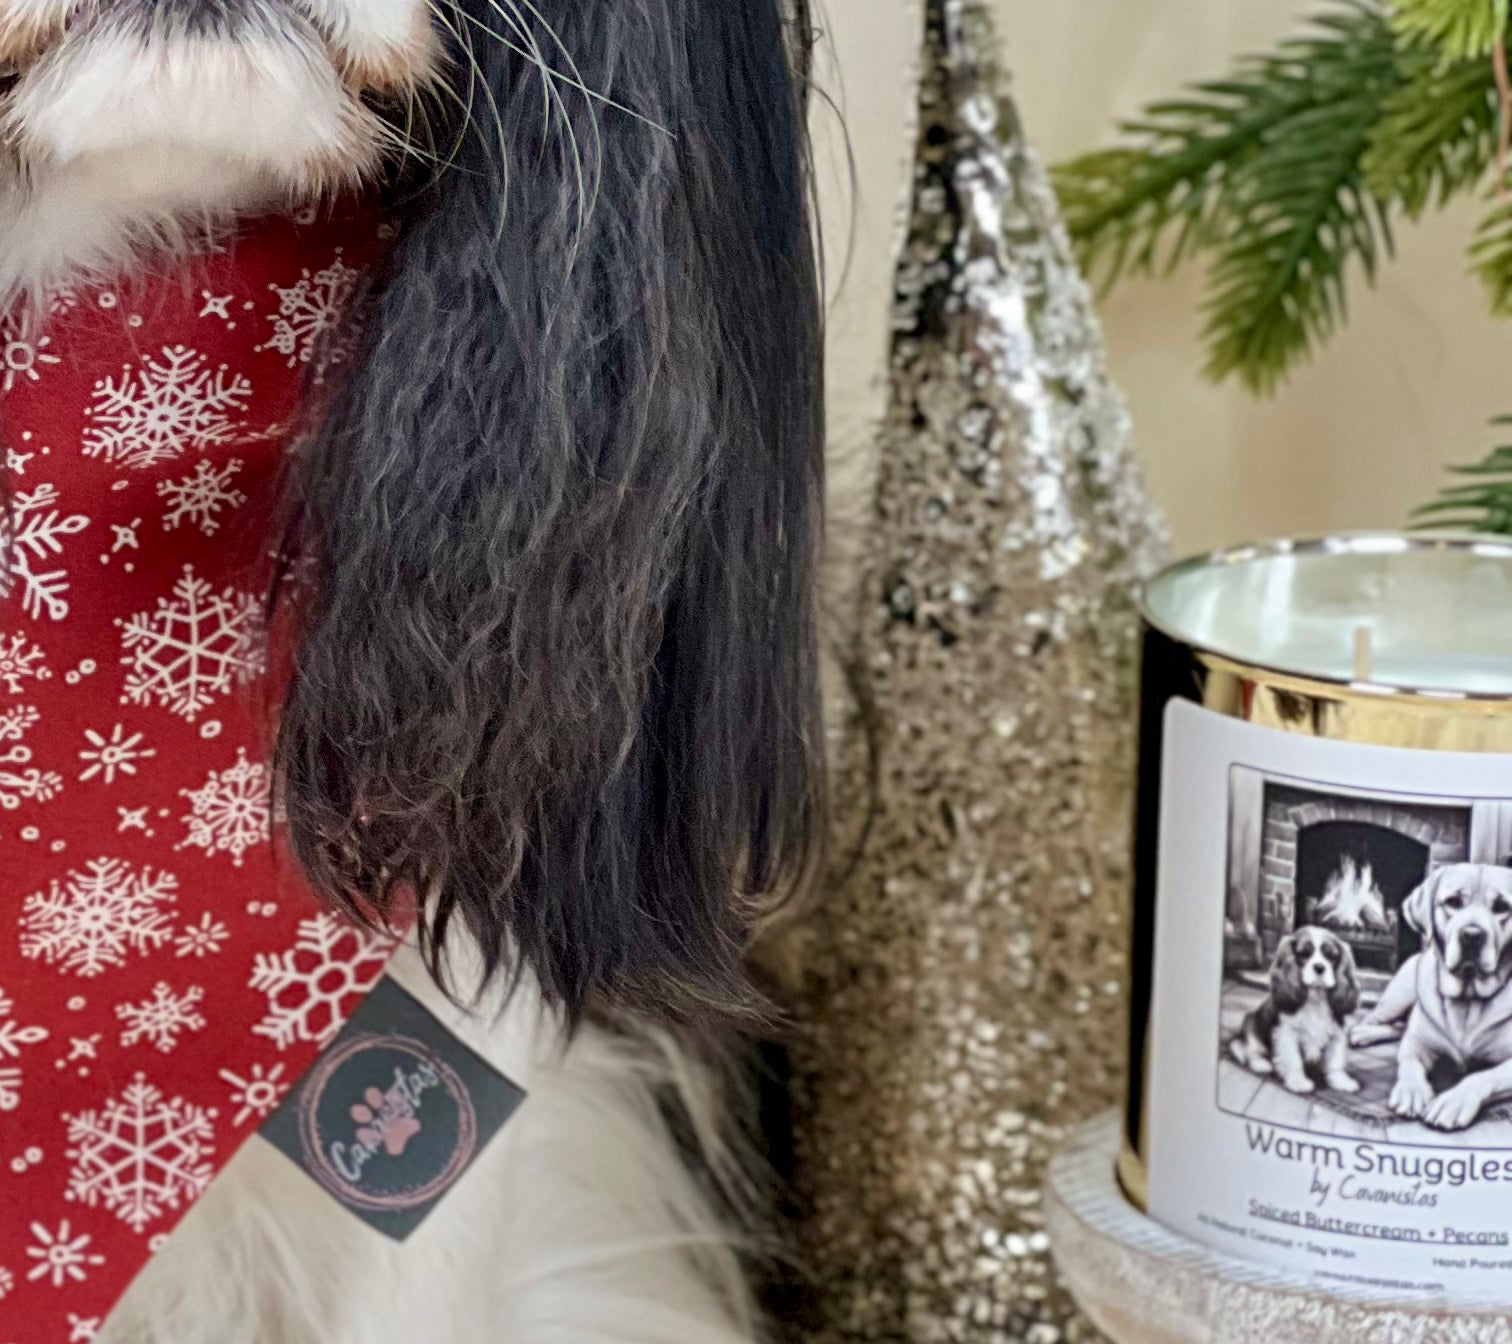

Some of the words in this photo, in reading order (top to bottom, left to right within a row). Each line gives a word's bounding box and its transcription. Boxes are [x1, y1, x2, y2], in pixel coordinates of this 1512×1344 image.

[1245, 1123, 1345, 1170] Warm
[1354, 1144, 1512, 1187] Snuggles
[1310, 1166, 1332, 1207] by
[1338, 1174, 1439, 1208] Cavanistas
[1249, 1197, 1301, 1226] Spiced
[1305, 1210, 1422, 1241] Buttercream
[1443, 1227, 1510, 1246] Pecans
[1432, 1257, 1467, 1268] Hand
